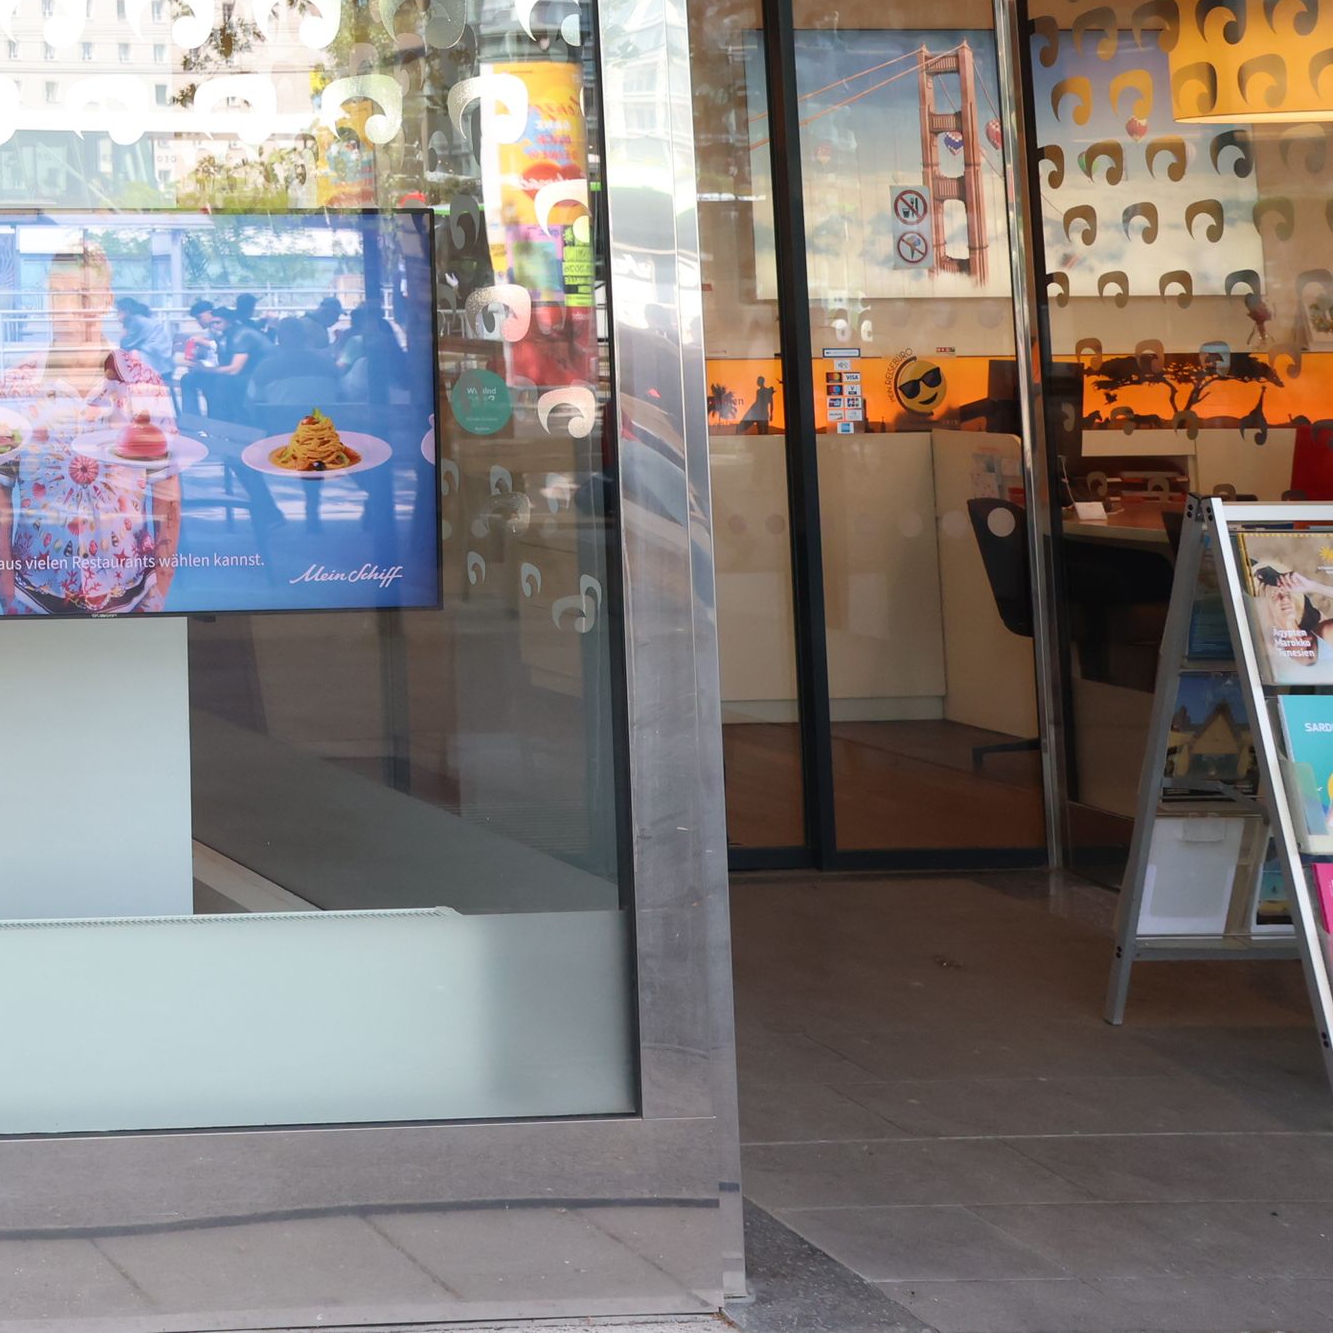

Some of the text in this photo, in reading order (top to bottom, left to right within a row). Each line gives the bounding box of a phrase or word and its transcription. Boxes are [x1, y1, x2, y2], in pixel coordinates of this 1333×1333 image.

[25, 555, 68, 571] vielen
[71, 554, 156, 570] Restaurants
[158, 553, 211, 568] wählen
[213, 552, 265, 568] kannst.
[289, 563, 404, 588] Mein Schiff
[1274, 637, 1312, 648] Marokko
[1304, 722, 1333, 733] SARD
